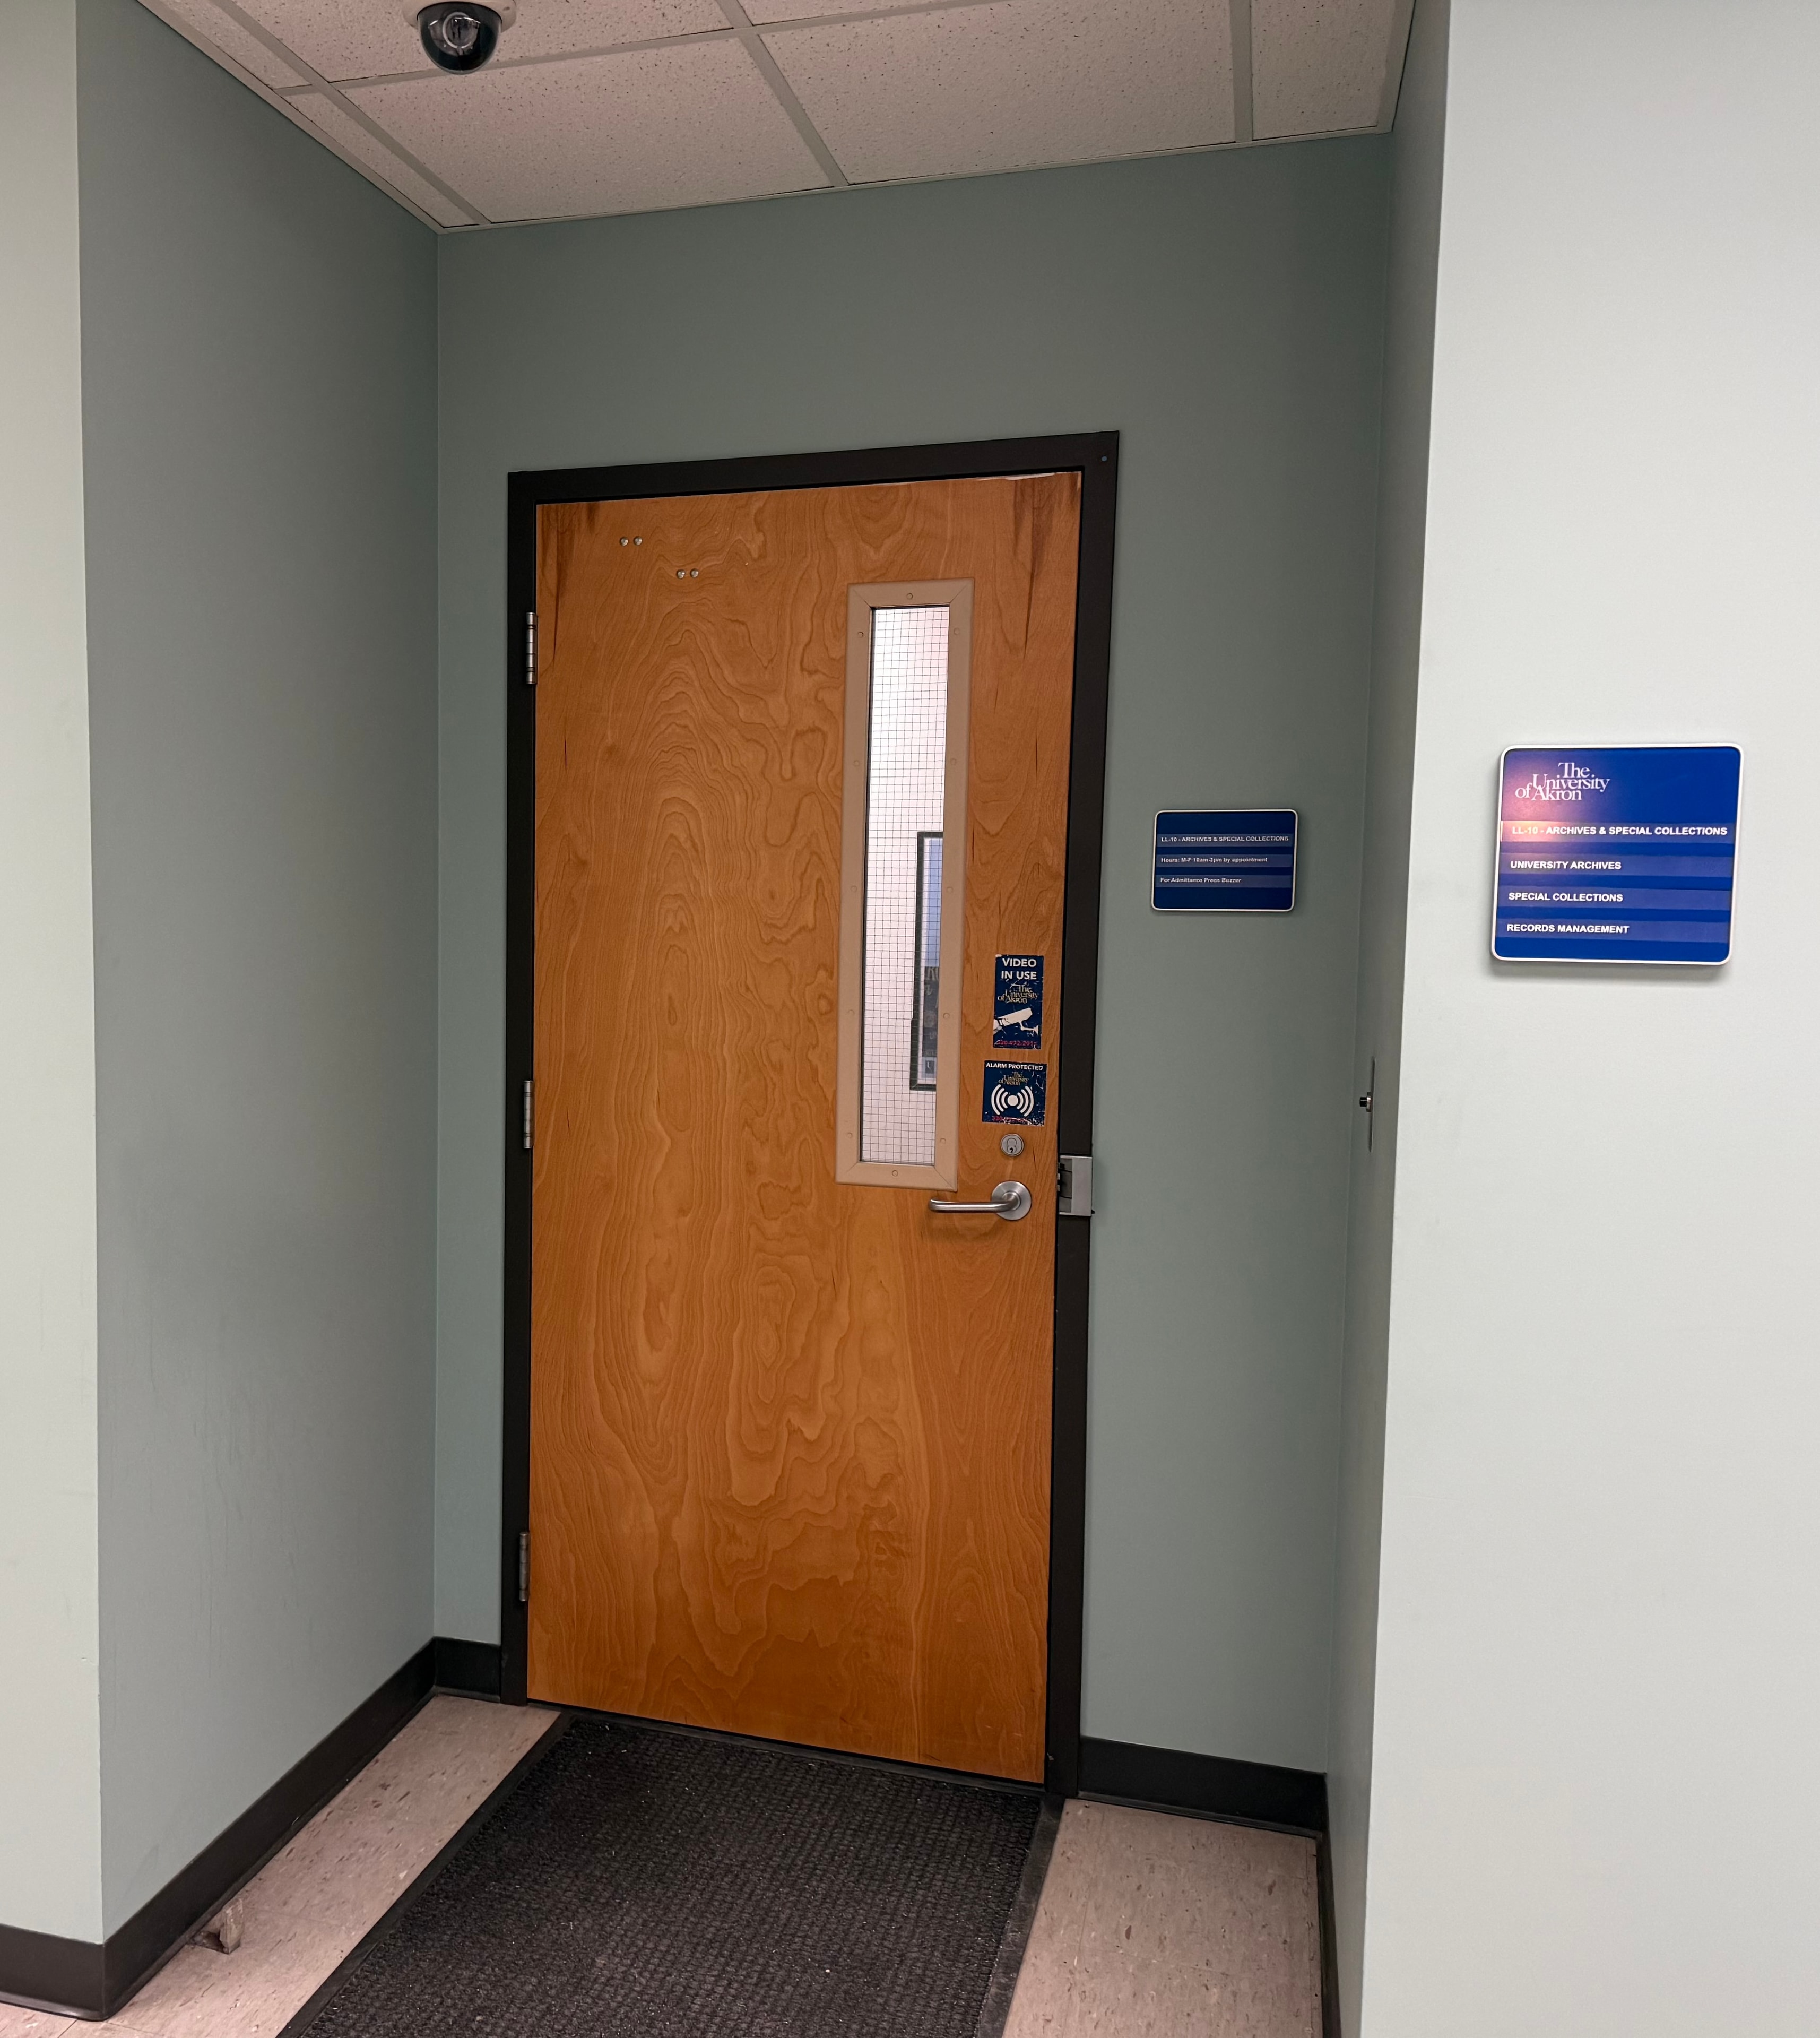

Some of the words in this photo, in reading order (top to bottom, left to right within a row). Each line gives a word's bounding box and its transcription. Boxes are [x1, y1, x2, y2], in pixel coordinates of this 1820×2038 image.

[1558, 762, 1590, 778] The
[1533, 774, 1610, 792] University
[1515, 783, 1532, 798] of
[1531, 785, 1582, 801] Akron
[1512, 826, 1538, 835] LL-10
[1546, 826, 1597, 835] ARCHIVES
[1609, 827, 1652, 835] SPECIAL
[1654, 827, 1728, 836] COLLECTIONS
[1510, 861, 1568, 869] UNIVERSITY
[1570, 861, 1622, 870] ARCHIVES
[1509, 892, 1550, 901] SPECIAL
[1553, 893, 1623, 902] COLLECTIONS
[1507, 924, 1555, 932] RECORDS
[1557, 925, 1630, 934] MANAGEMENT
[1002, 958, 1037, 968] VIDEO
[1001, 971, 1012, 979] IN
[1017, 971, 1037, 980] USE
